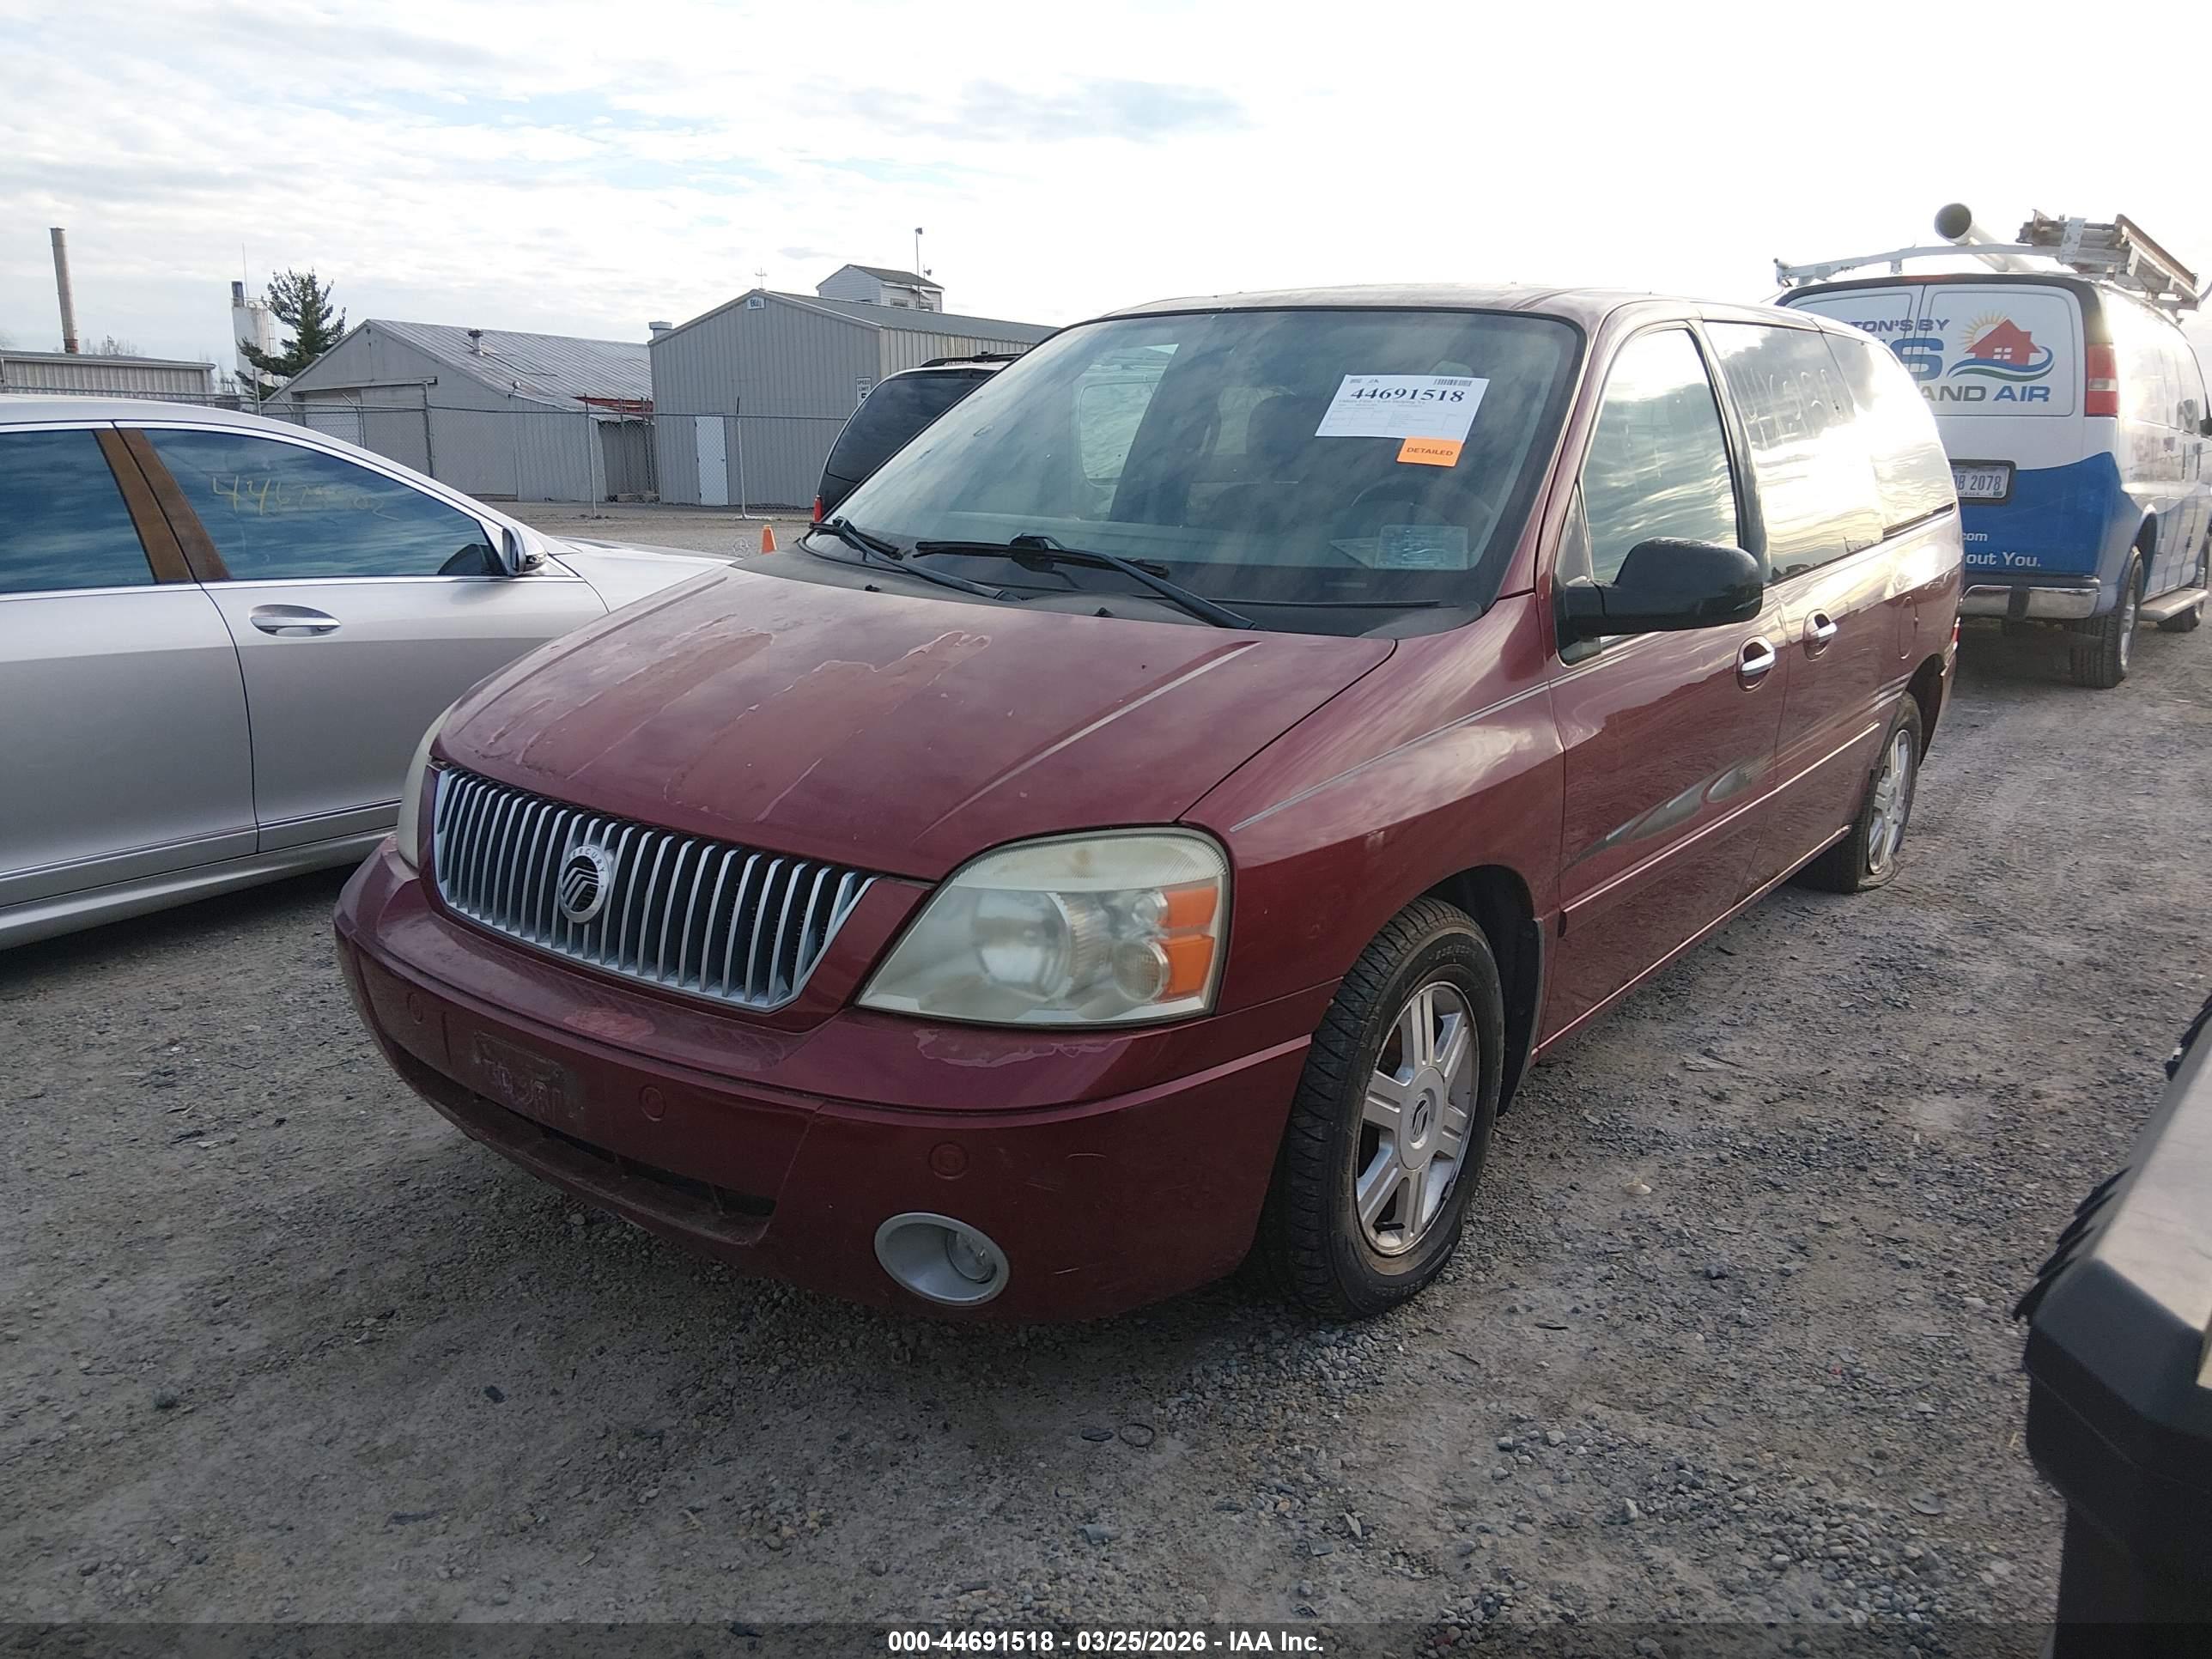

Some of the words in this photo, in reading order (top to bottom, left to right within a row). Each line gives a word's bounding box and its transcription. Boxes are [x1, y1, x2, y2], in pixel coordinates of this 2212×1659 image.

[1918, 319, 1951, 331] BY
[1350, 387, 1466, 403] 44691518
[1920, 386, 1987, 402] AND
[1992, 386, 2051, 403] AIR
[1406, 447, 1454, 457] DETAILED
[1970, 475, 2002, 490] 2078
[2002, 551, 2042, 567] You.
